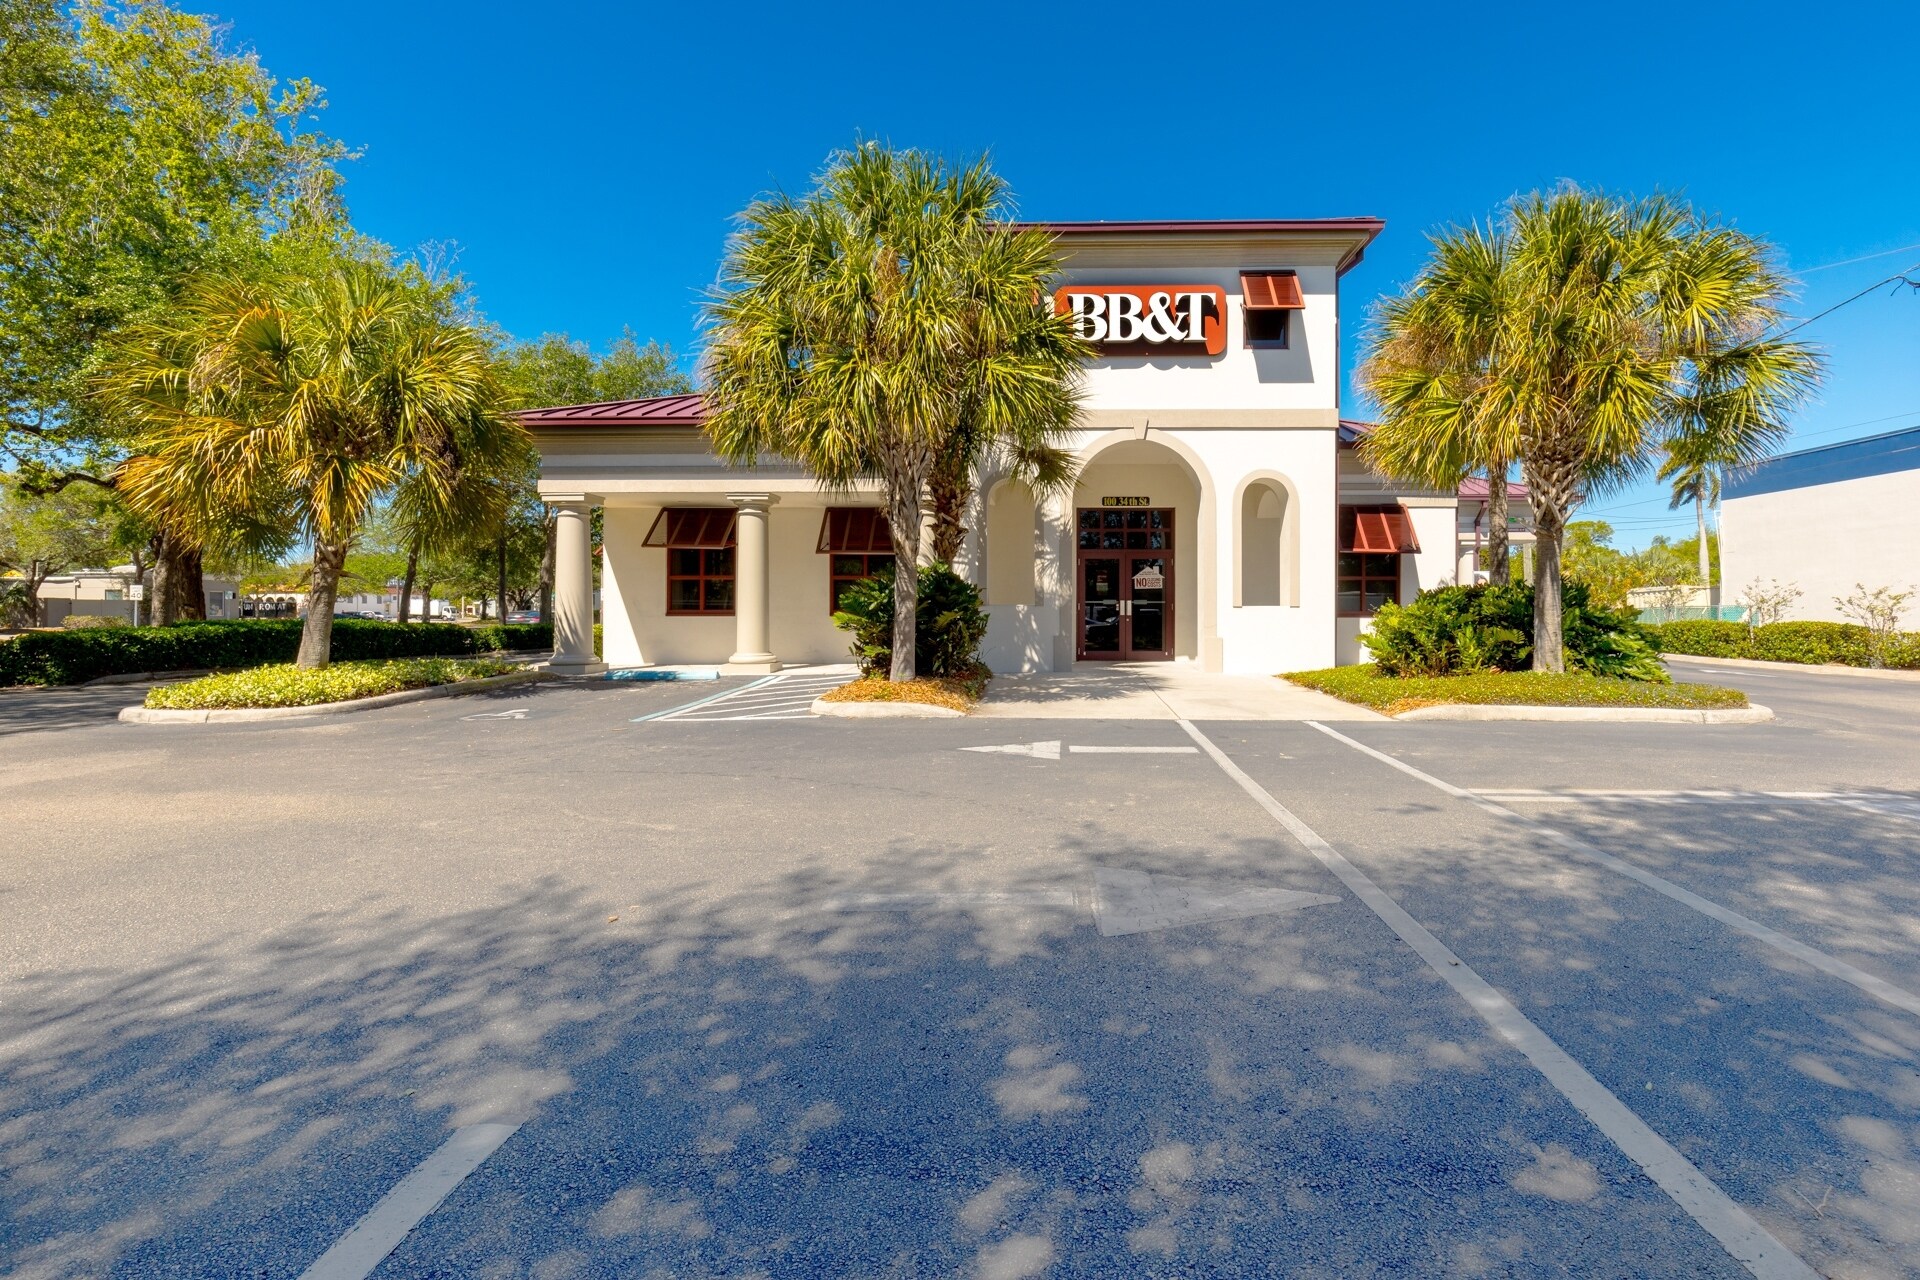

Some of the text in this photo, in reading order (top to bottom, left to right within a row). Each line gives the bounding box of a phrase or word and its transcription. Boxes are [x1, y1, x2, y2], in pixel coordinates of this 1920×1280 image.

[1066, 291, 1217, 343] BB&T
[1104, 497, 1117, 506] 100
[1136, 578, 1146, 587] NO
